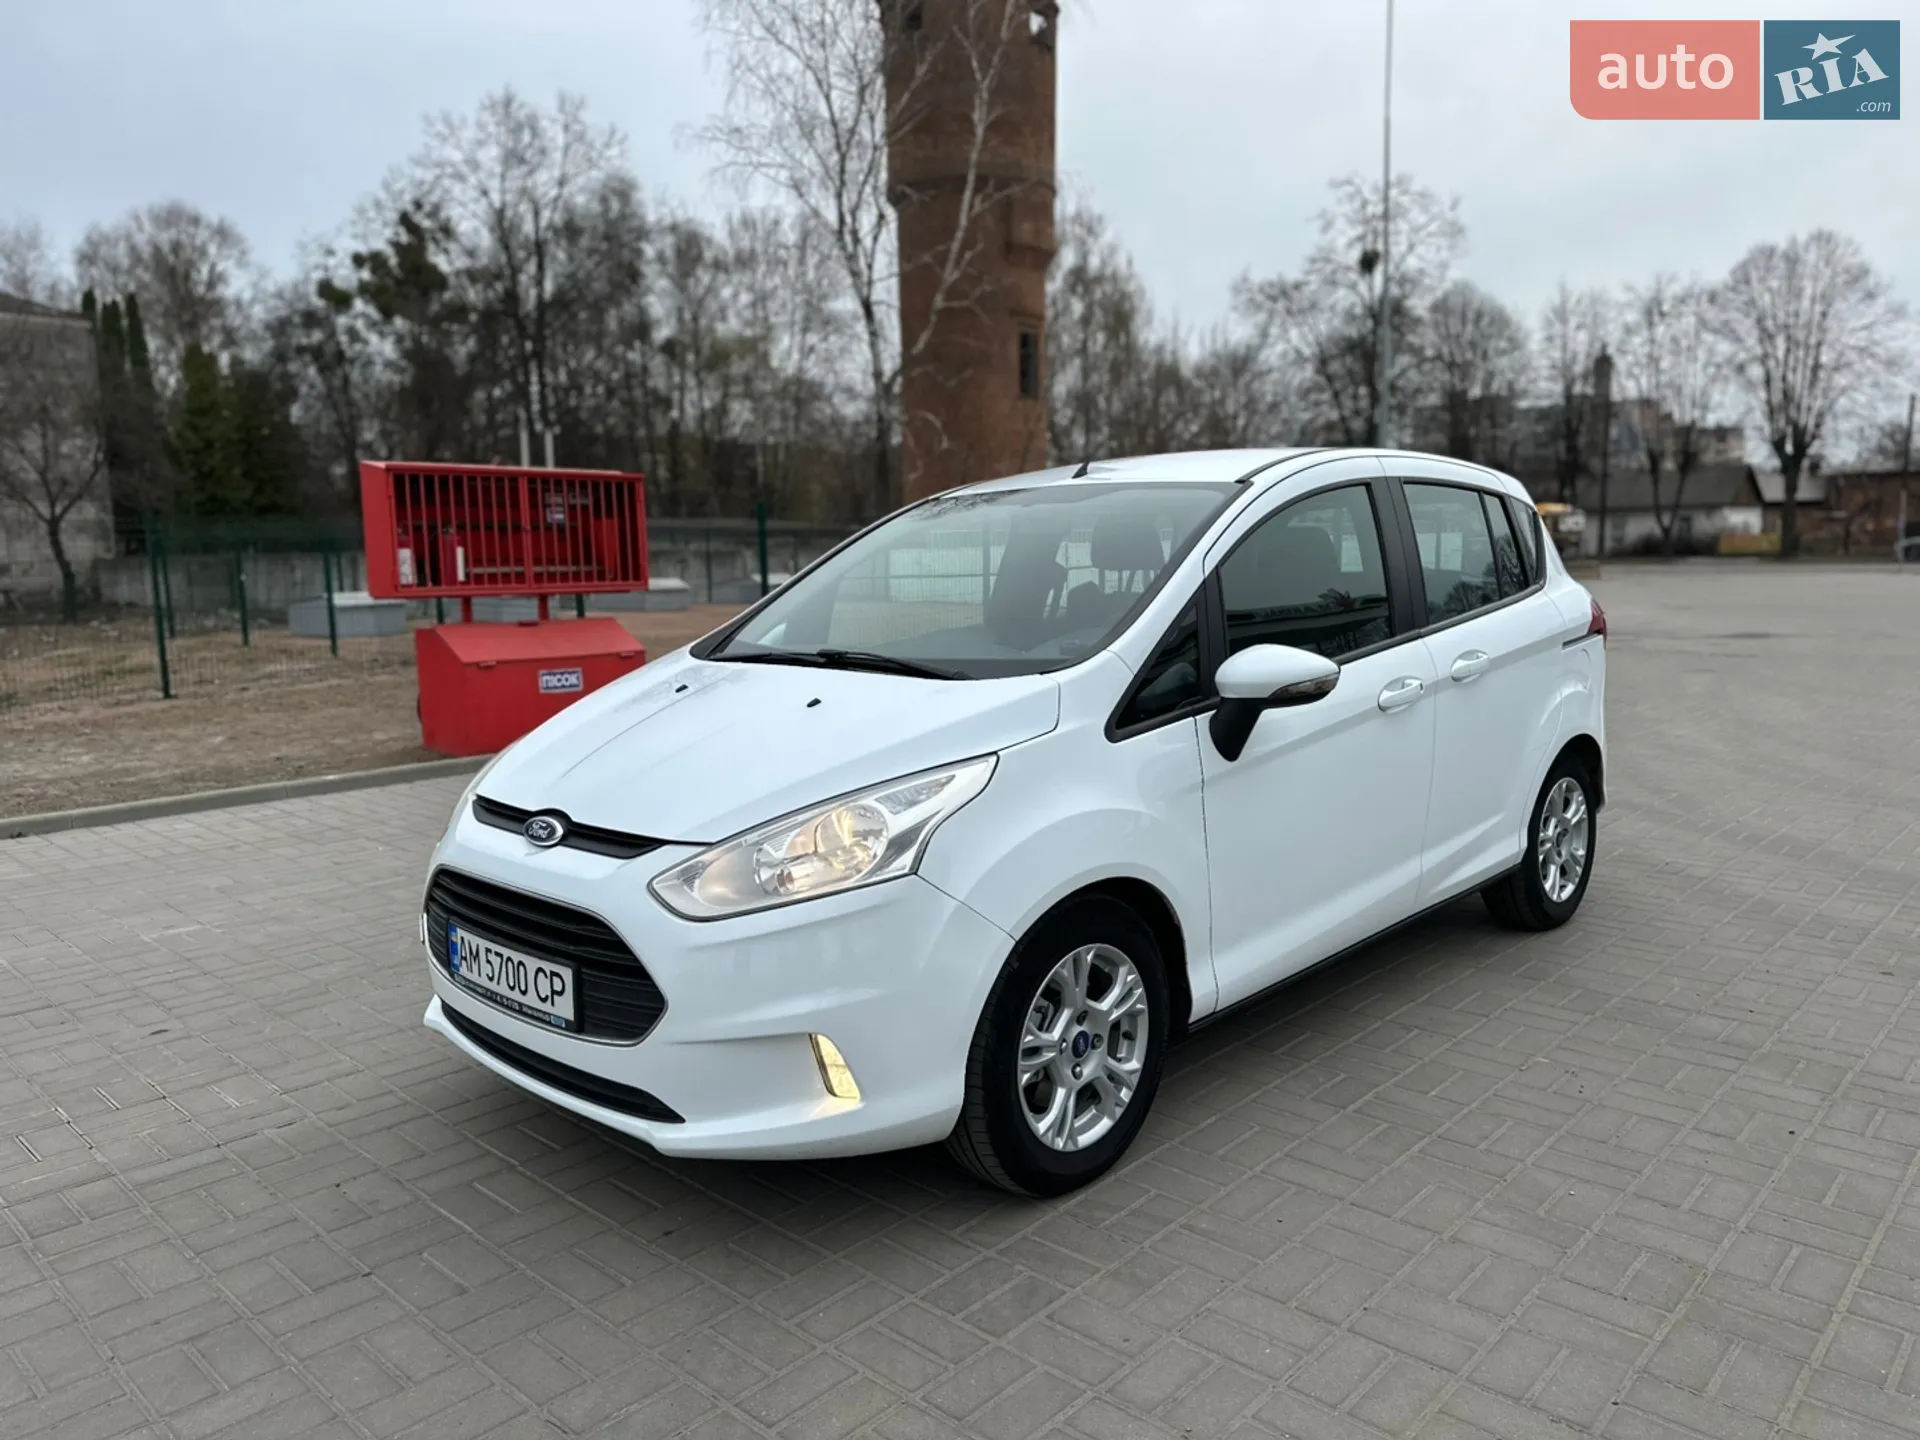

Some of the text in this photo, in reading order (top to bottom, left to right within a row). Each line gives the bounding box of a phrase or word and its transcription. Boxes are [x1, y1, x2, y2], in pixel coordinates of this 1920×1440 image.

[528, 821, 551, 838] Ford
[460, 936, 481, 978] AM
[485, 947, 528, 996] 5700
[534, 966, 566, 1007] CP
